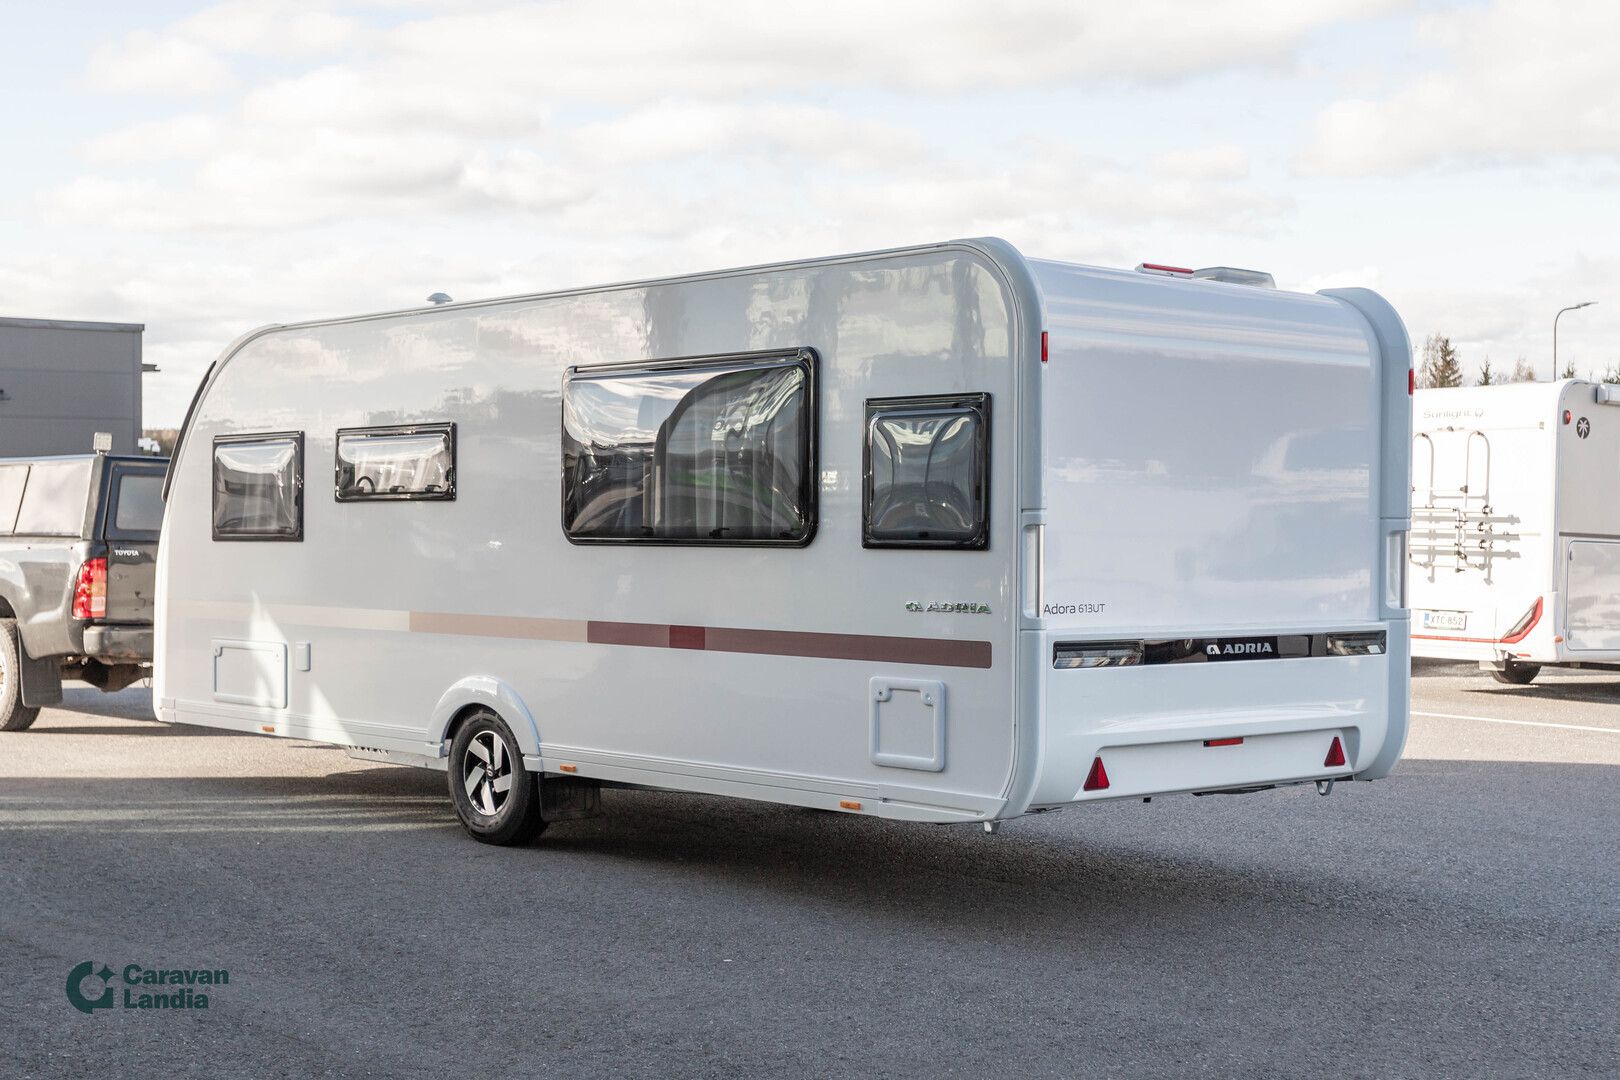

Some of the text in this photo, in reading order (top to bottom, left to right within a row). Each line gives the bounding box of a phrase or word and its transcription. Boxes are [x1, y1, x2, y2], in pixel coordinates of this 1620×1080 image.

[114, 549, 140, 557] TOYOTA
[926, 601, 992, 614] ADRIA
[1044, 603, 1105, 615] Adora 613UT
[1223, 642, 1273, 654] ADRIA
